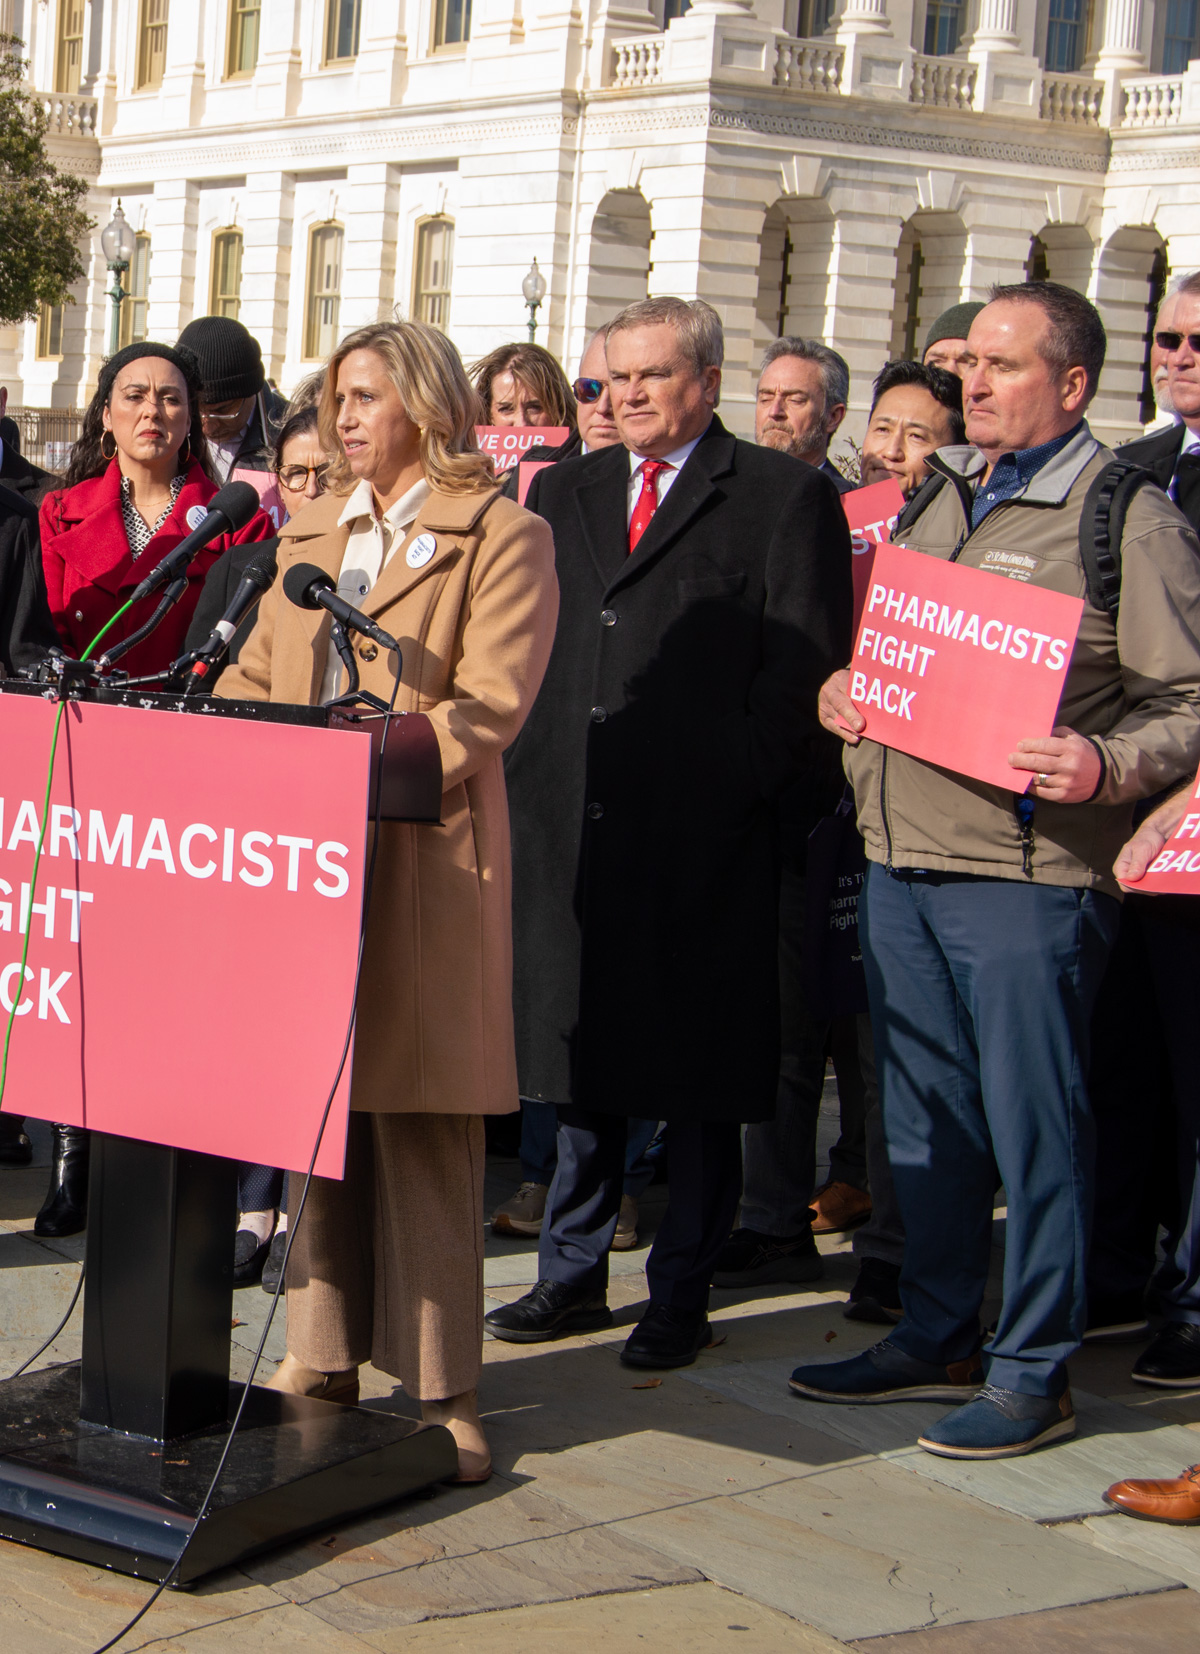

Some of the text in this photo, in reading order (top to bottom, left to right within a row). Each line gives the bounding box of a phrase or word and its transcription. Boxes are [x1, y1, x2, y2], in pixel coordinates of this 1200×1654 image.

[503, 434, 545, 450] OUR
[858, 627, 936, 677] FIGHT
[868, 583, 1068, 671] PHARMACISTS
[851, 671, 917, 721] BACK
[838, 876, 853, 887] It's
